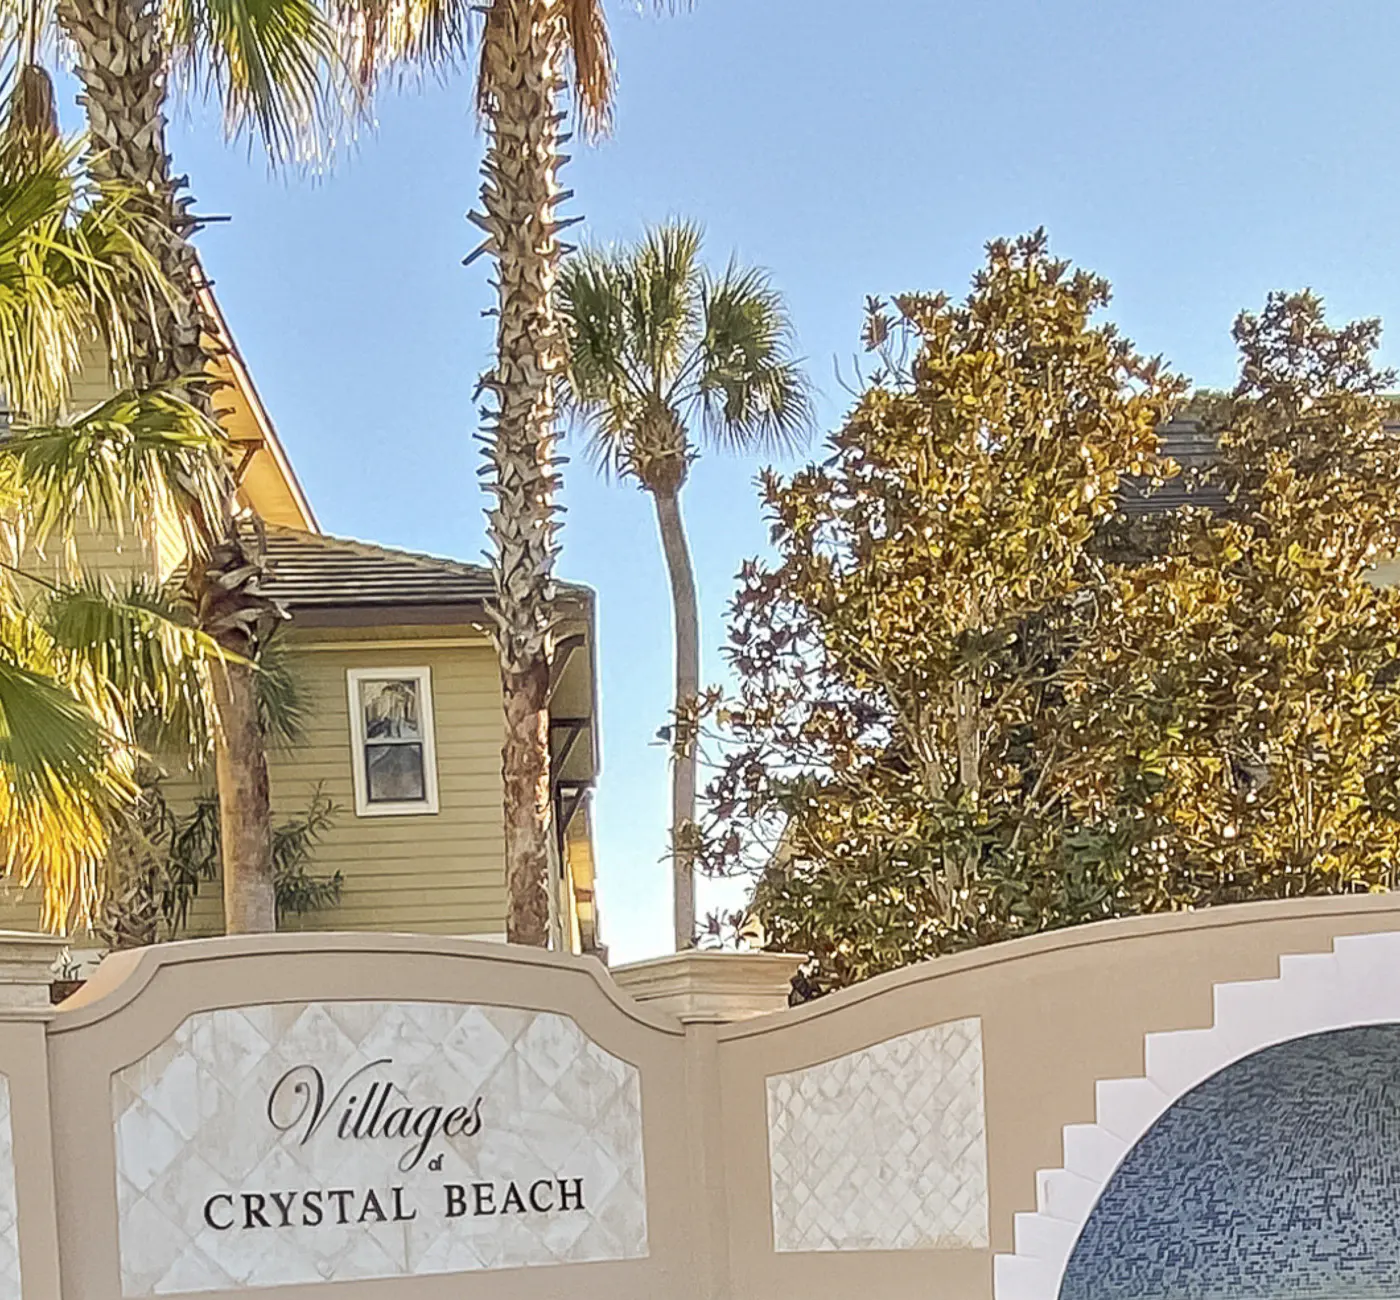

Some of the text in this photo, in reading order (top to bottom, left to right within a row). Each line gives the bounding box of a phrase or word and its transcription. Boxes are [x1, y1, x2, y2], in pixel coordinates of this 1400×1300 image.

[267, 1059, 483, 1172] Villages
[428, 1153, 445, 1172] of
[204, 1178, 585, 1230] CRYSTAL BEACH
